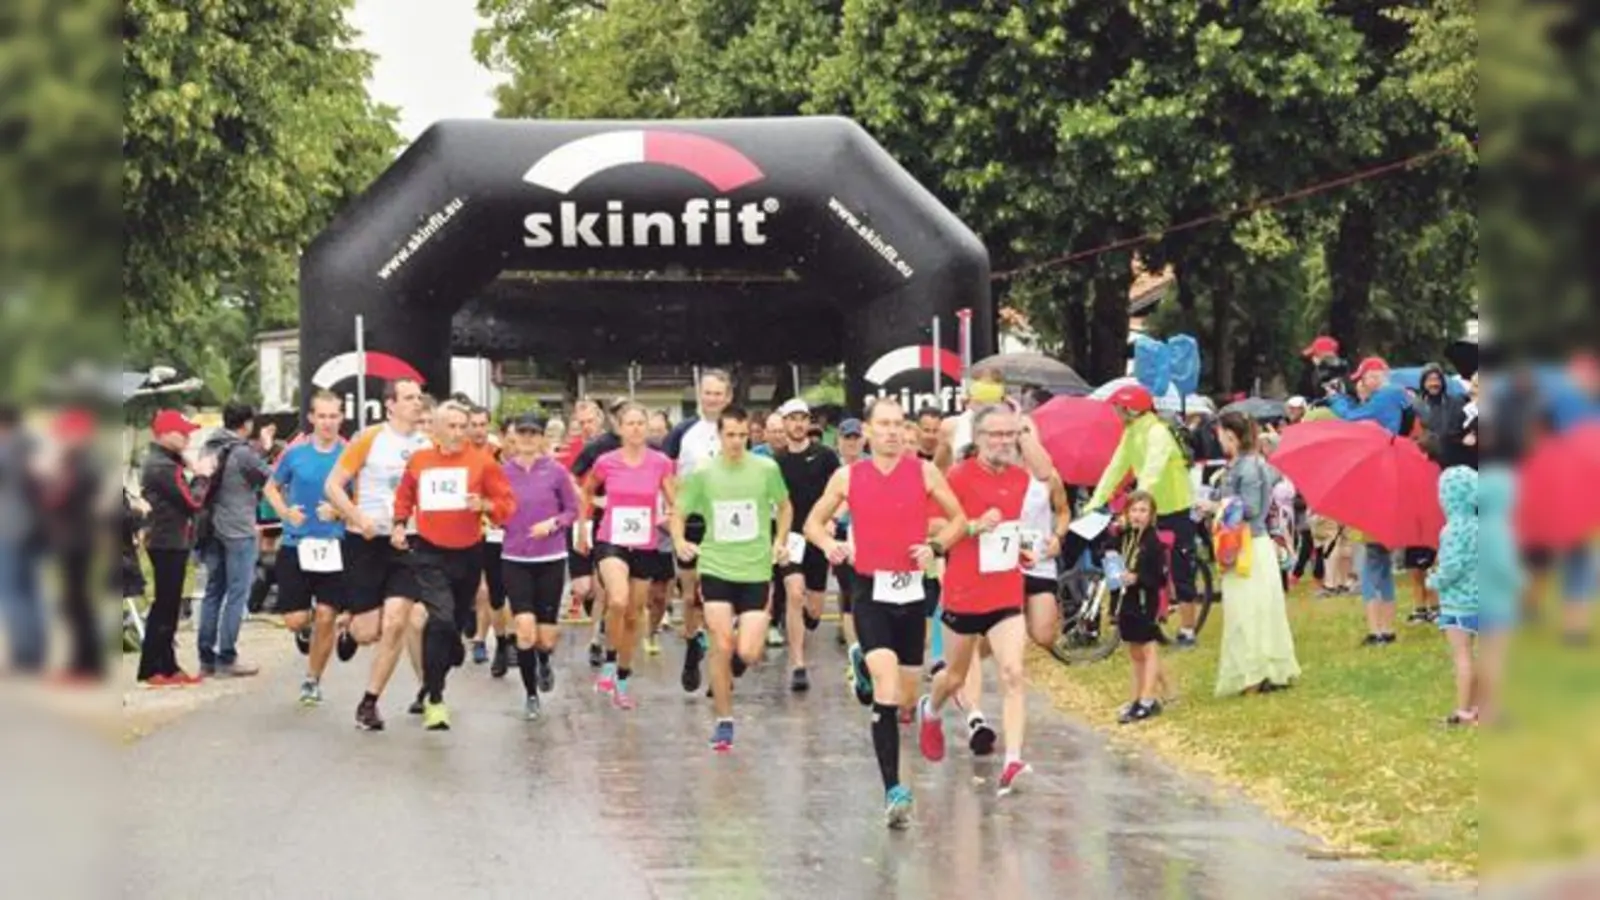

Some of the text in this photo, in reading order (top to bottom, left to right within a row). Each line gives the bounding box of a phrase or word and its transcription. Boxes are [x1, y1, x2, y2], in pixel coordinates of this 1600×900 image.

[377, 197, 464, 280] www.skinfit.eu
[828, 196, 914, 278] www.skinfit.eu
[431, 479, 458, 495] 142
[729, 511, 742, 527] 4
[1000, 535, 1011, 553] 7
[312, 546, 328, 562] 17
